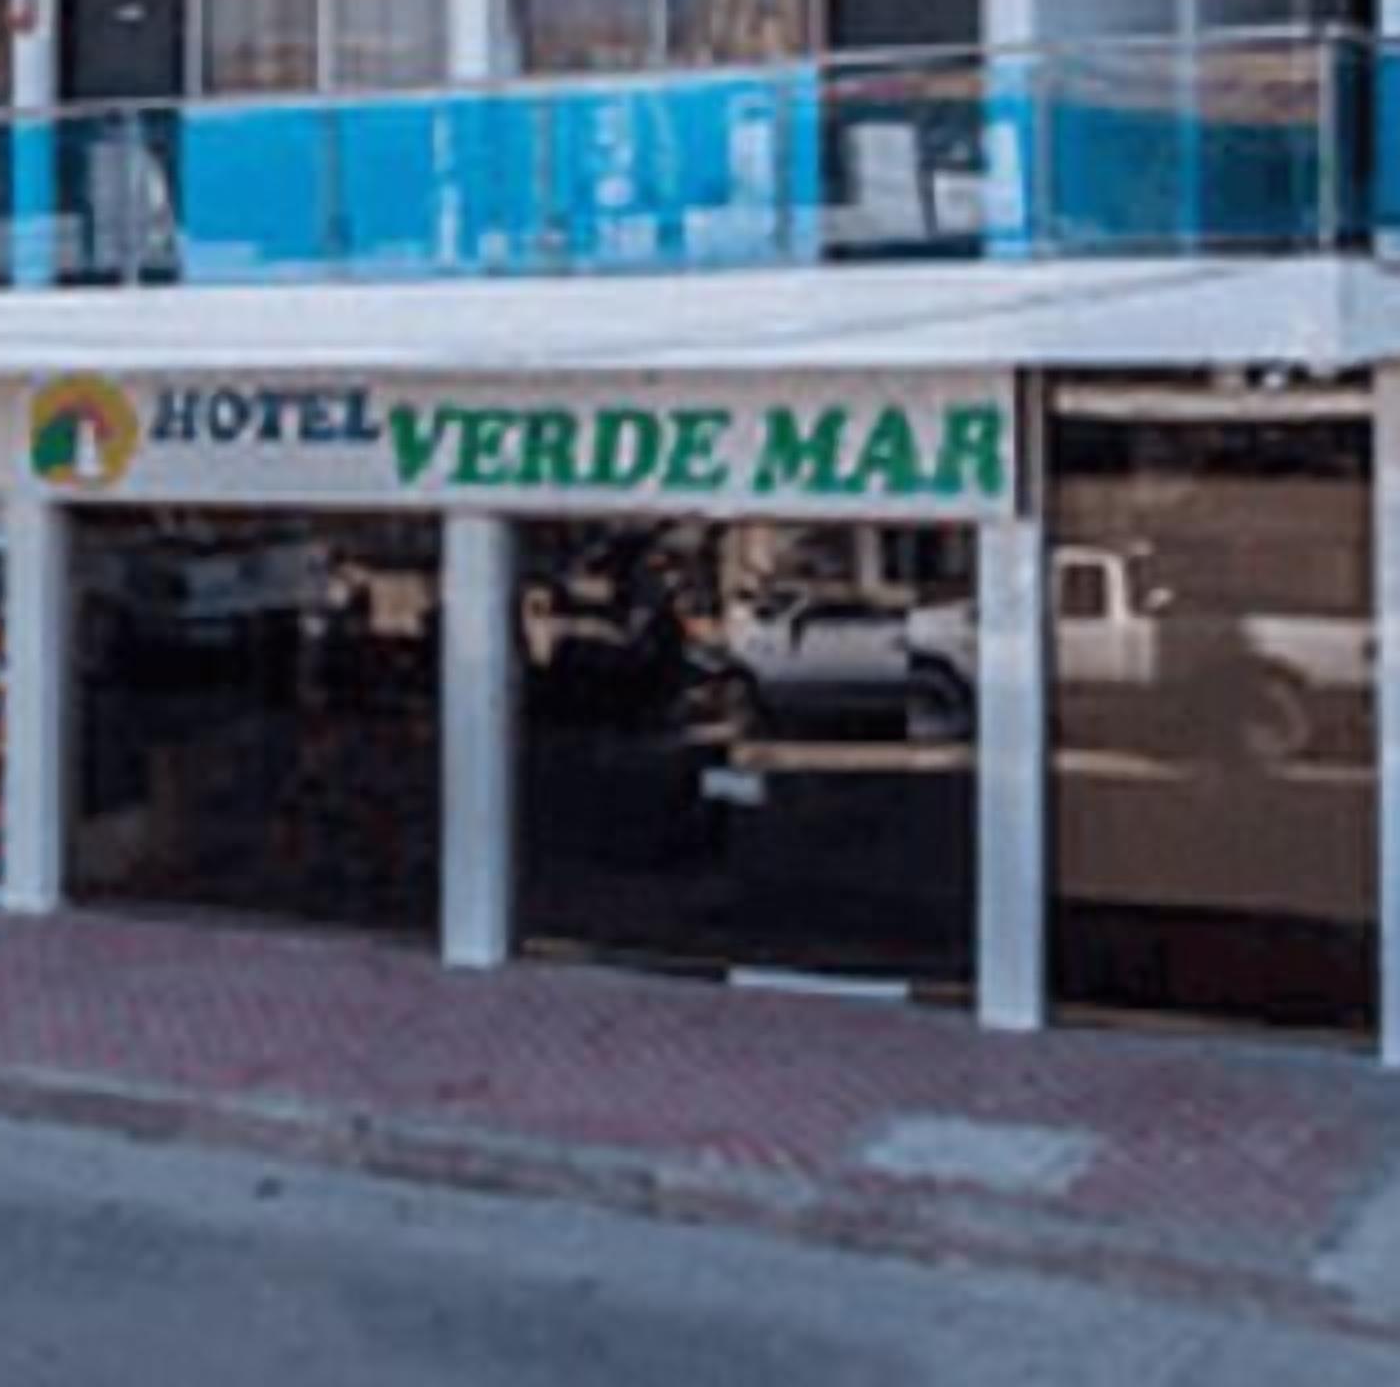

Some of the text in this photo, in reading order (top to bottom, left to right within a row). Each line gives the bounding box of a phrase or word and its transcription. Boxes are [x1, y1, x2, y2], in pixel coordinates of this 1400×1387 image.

[150, 386, 1002, 495] HOTEL VERDE MAR
